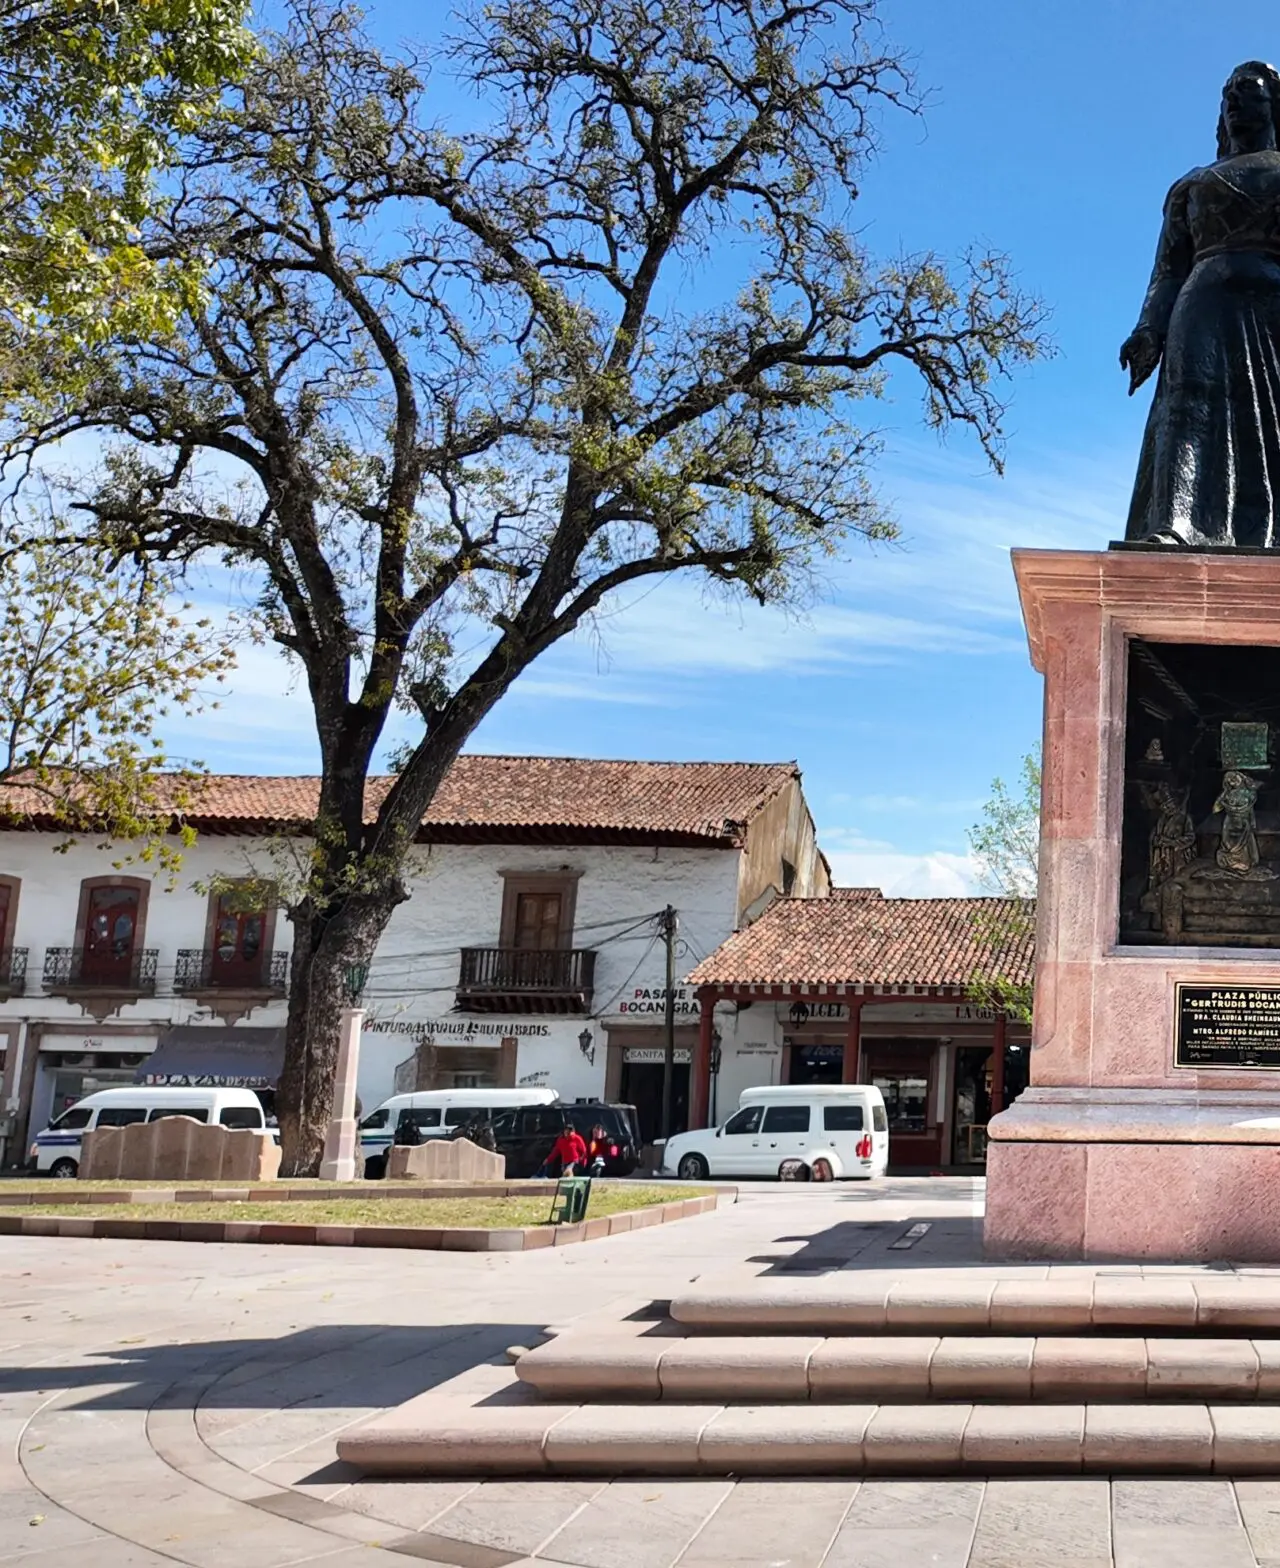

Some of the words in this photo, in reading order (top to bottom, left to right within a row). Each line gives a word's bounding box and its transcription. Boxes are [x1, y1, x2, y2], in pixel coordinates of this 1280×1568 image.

[634, 988, 686, 1000] PASAJE
[1211, 991, 1246, 1000] PLAZA
[619, 1001, 701, 1014] BOCANGRA
[1248, 1027, 1279, 1036] RAMÍREZ
[630, 1051, 687, 1060] SANITAOS
